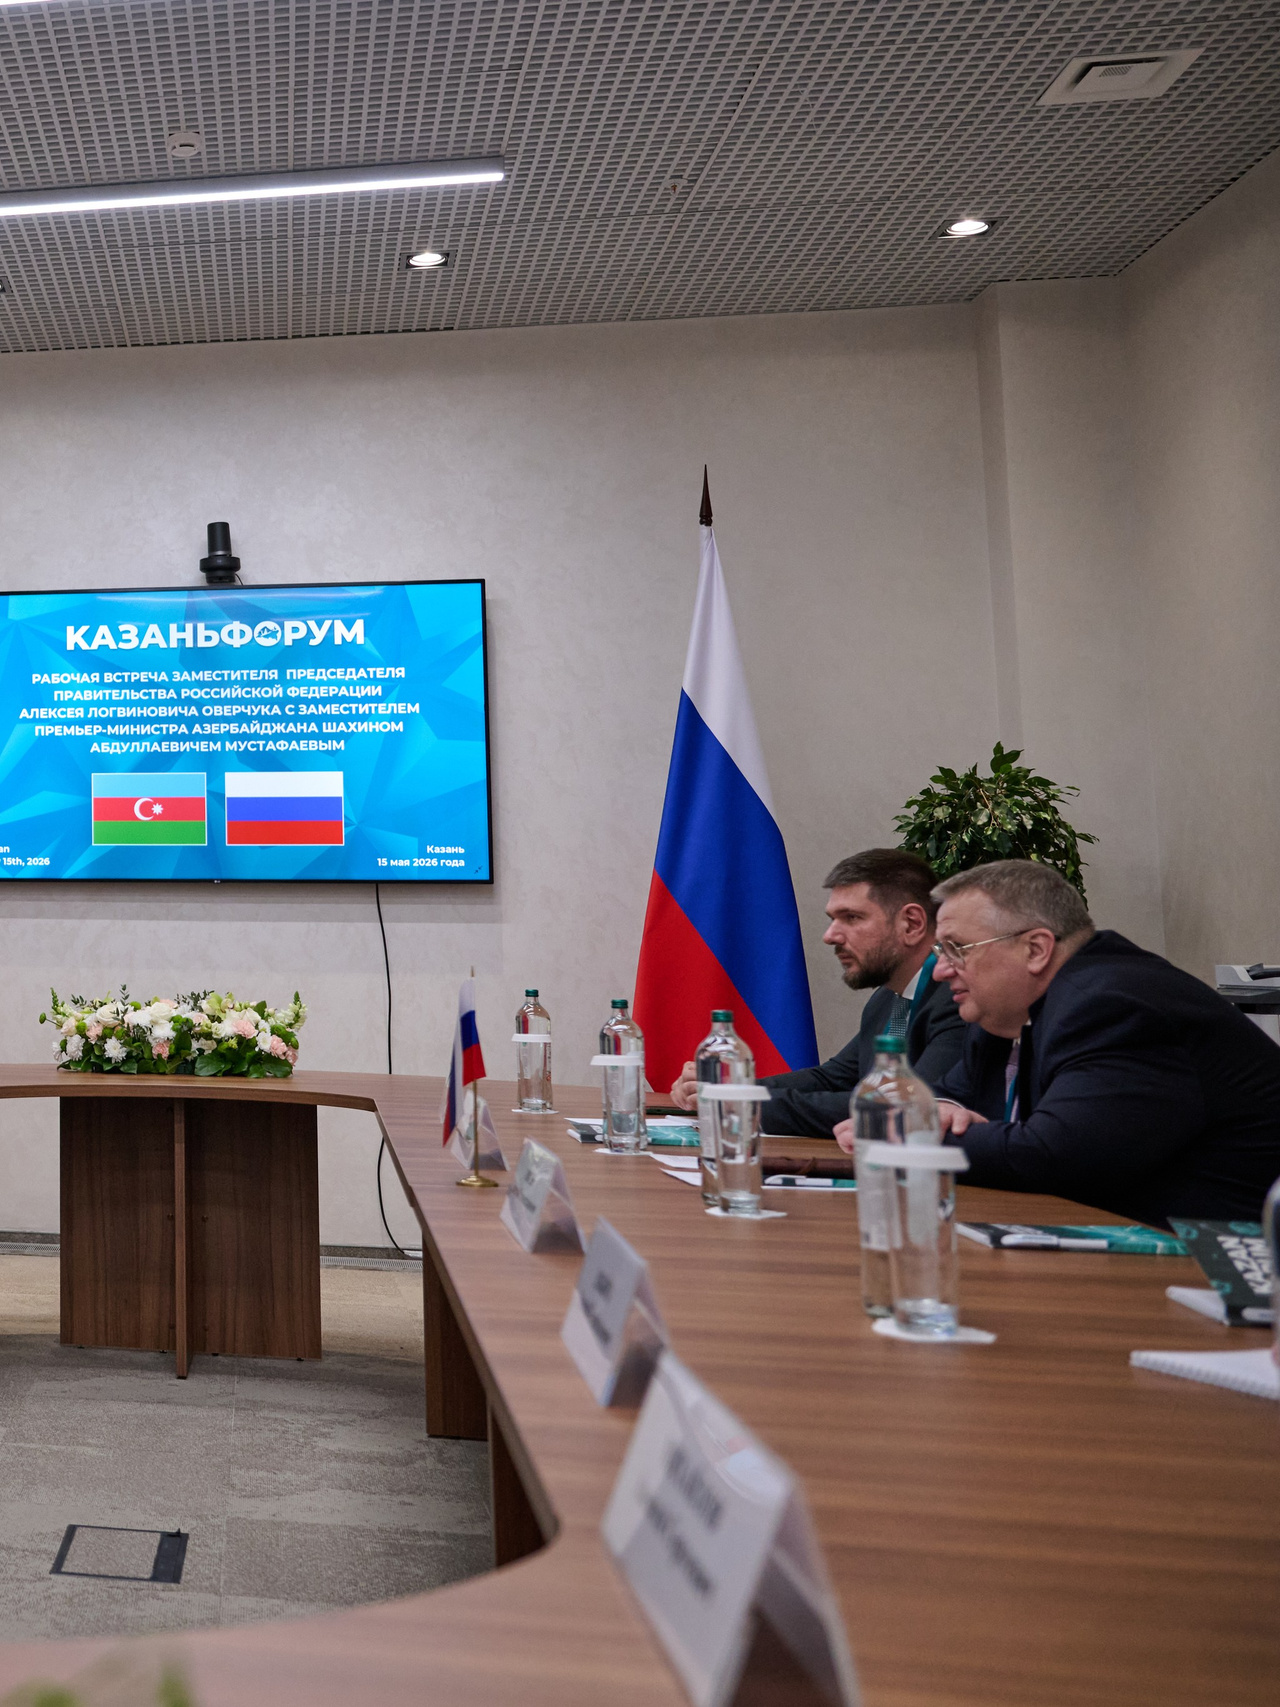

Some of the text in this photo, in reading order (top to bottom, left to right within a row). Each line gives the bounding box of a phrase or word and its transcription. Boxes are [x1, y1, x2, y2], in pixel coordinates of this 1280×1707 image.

[66, 618, 365, 651] КАЗАНЬФОРУМ
[31, 666, 406, 685] РАБОЧАЯ ВСТРЕЧА ЗАМЕСТИТЕЛЯ ПРЕДСЕДАТЕЛЯ
[53, 684, 382, 701] ПРАВИТЕЛЬСТВА РОССИЙСКОЙ ФЕДЕРАЦИИ
[18, 702, 420, 719] АЛЕКСЕЯ ЛОГВИНОВИЧА ОВЕРЧУКА С ЗАМЕСТИТЕЛЕМ
[34, 720, 404, 737] ПРЕМЬЕР-МИНИСТРА АЗЕРБАЙДЖАНА ШАХИНОМ
[89, 739, 345, 755] АБДУЛЛАЕВИЧЕМ МУСТАФАЕВЫМ
[426, 844, 465, 854] Казань
[2, 856, 25, 867] 15th,
[26, 857, 51, 866] 2026
[376, 857, 465, 868] 15 мая 2026 года
[1217, 1235, 1271, 1294] KAZAN
